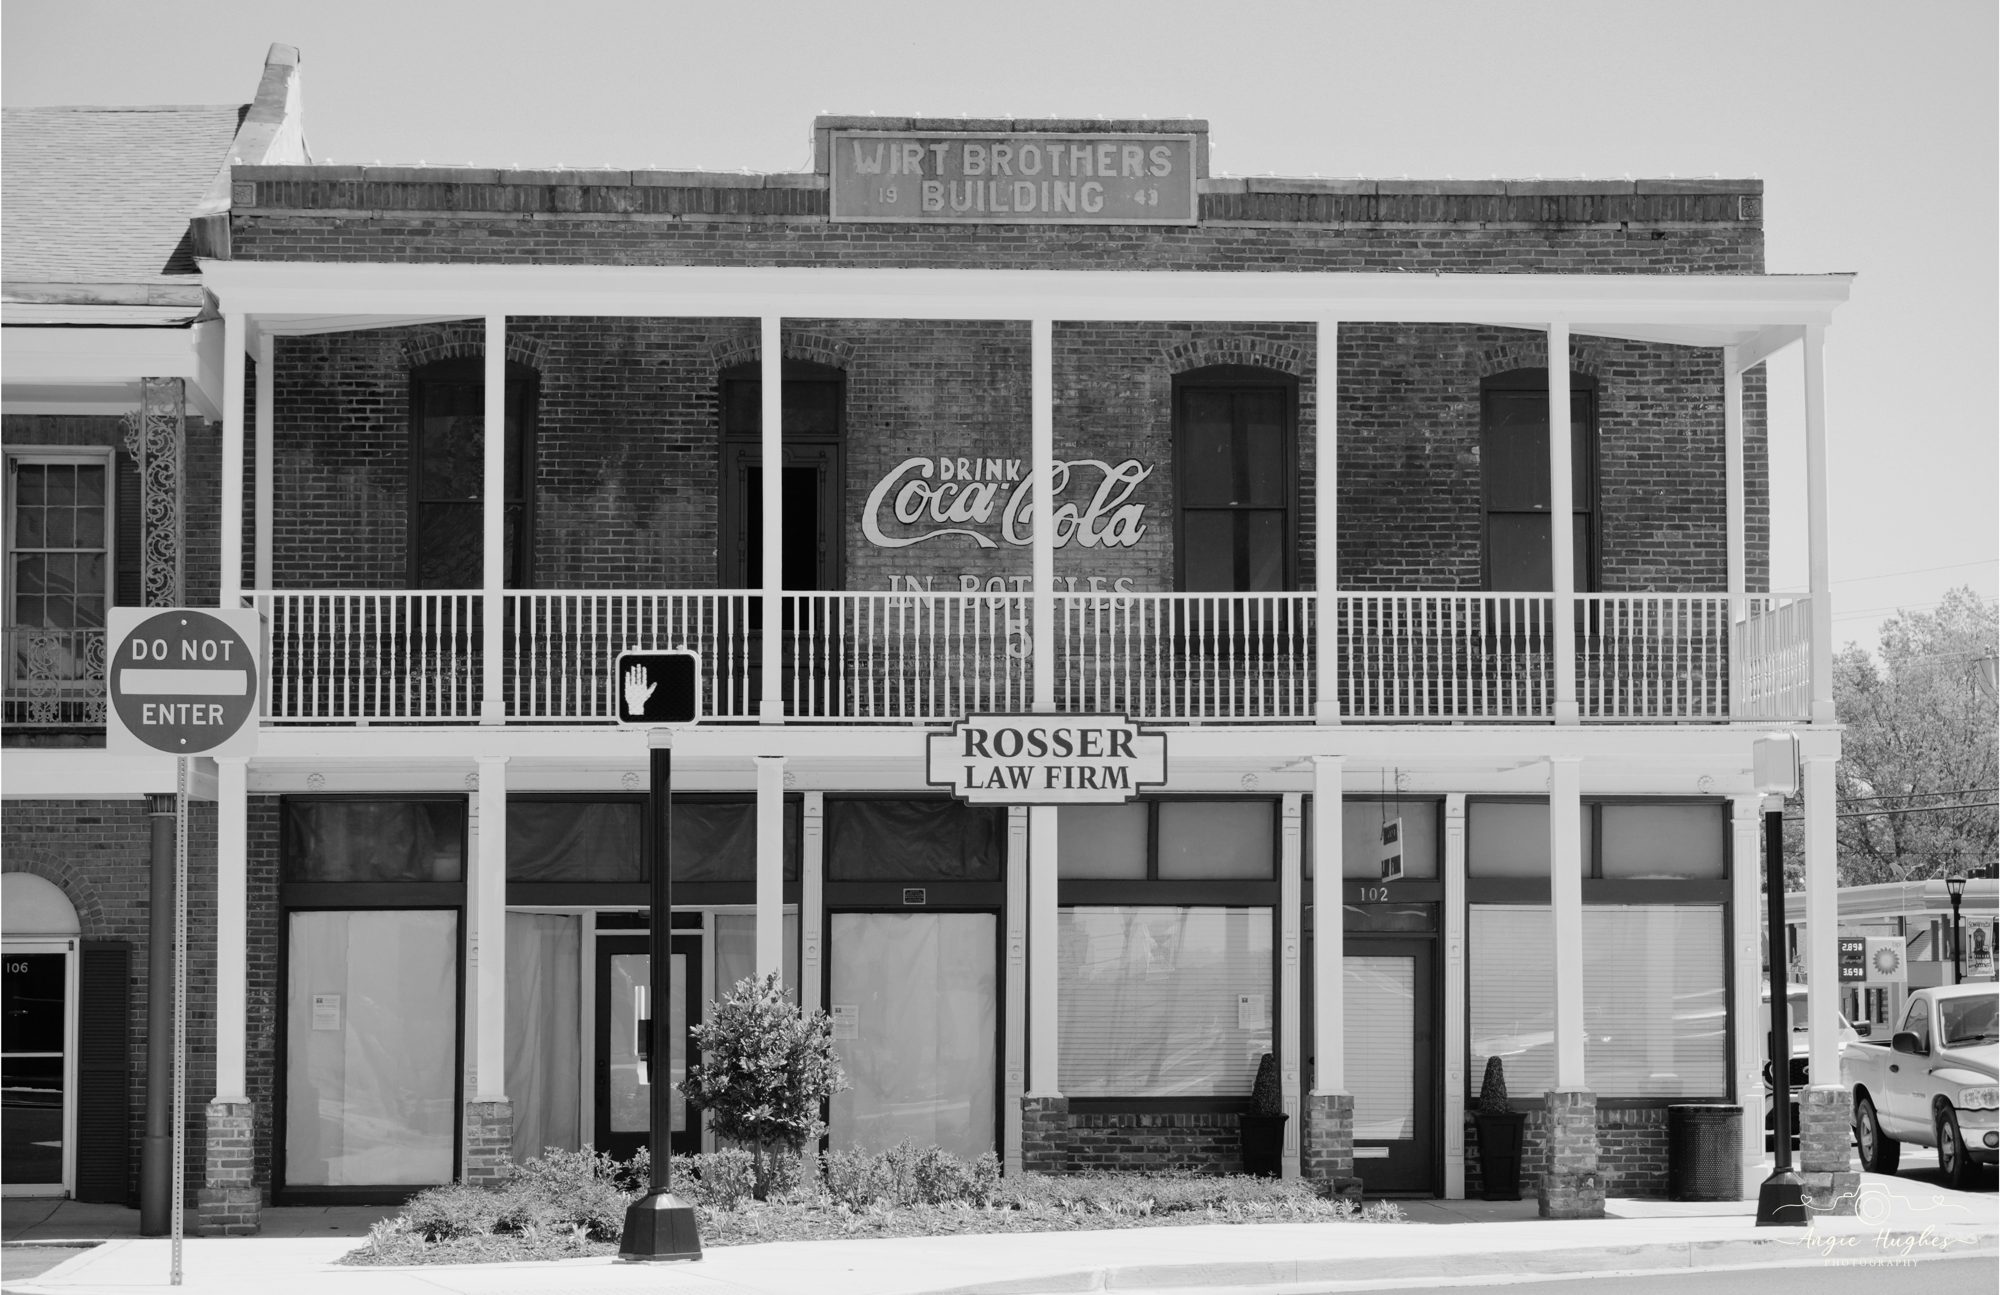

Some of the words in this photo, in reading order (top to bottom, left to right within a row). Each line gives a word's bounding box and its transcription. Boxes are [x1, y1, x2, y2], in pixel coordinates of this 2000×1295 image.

[853, 140, 950, 176] WIRT
[963, 143, 1173, 178] BROTHERS
[879, 186, 898, 204] 19
[921, 180, 1104, 213] BUILDING
[940, 457, 1022, 481] DRINK
[861, 457, 1155, 549] Coca-Cola
[888, 574, 934, 609] IN
[132, 639, 168, 661] DO
[181, 639, 234, 662] NOT
[142, 703, 224, 726] ENTER
[961, 728, 1138, 759] ROSSER
[963, 765, 1036, 790] LAW
[1043, 765, 1132, 790] FIRM
[1360, 887, 1389, 902] 102
[6, 962, 29, 974] 106
